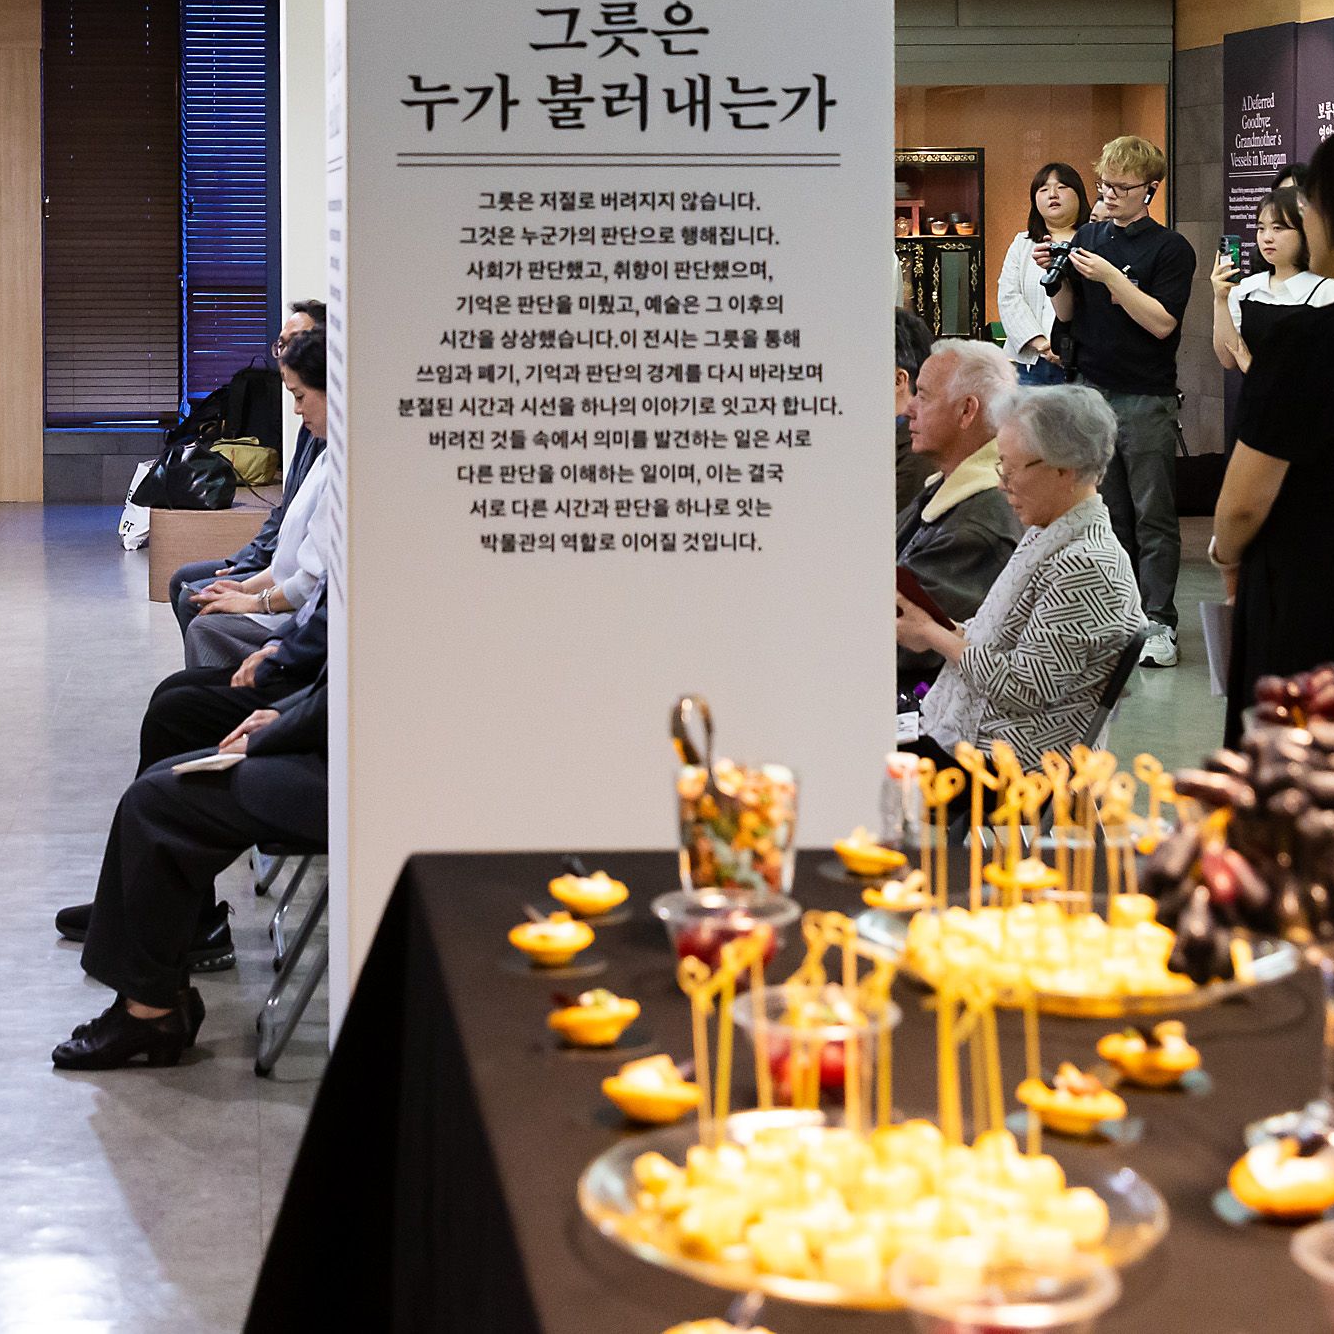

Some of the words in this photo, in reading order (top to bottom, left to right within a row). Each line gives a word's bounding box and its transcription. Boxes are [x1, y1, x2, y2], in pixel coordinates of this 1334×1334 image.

[529, 0, 710, 59] 그릇은
[400, 72, 520, 132] 누가
[1241, 96, 1247, 112] A
[1247, 92, 1275, 111] Deferred
[1230, 152, 1252, 168] Vessels
[1252, 151, 1259, 167] in
[1259, 150, 1287, 170] Yeongam
[479, 191, 535, 212] 그릇은
[540, 191, 595, 212] 저절로
[601, 191, 675, 212] 버려지지
[681, 191, 760, 212] 않습니다.
[460, 225, 515, 246] 그것은
[521, 225, 595, 246] 누군가의
[601, 225, 675, 246] 판단으로
[681, 225, 779, 246] 행해집니다.
[467, 260, 523, 281] 사회가
[528, 260, 608, 283] 판단했고,
[614, 260, 668, 281] 취향이
[674, 260, 773, 283] 판단했으며,
[456, 294, 511, 315] 기억은
[517, 294, 573, 315] 판단을
[579, 294, 639, 317] 미뤘고,
[644, 294, 700, 315] 예술은
[705, 294, 723, 315] 그
[728, 294, 783, 315] 이후의
[439, 329, 495, 350] 시간을
[500, 329, 637, 350] 상상했습니다.이
[643, 329, 698, 350] 전시는
[704, 329, 759, 350] 그릇을
[764, 329, 800, 350] 통해
[417, 363, 473, 384] 쓰임과
[478, 363, 520, 386] 폐기,
[525, 363, 581, 384] 기억과
[586, 363, 641, 384] 판단의
[647, 363, 702, 384] 경계를
[708, 363, 743, 384] 다시
[749, 363, 823, 384] 바라보며
[398, 395, 453, 416] 분절된
[459, 395, 514, 416] 시간과
[521, 395, 576, 416] 시선을
[581, 395, 636, 416] 하나의
[642, 395, 716, 416] 이야기로
[721, 395, 777, 416] 잇고자
[782, 395, 843, 416] 합니다.
[429, 429, 484, 450] 버려진
[491, 429, 527, 450] 것들
[532, 429, 587, 450] 속에서
[593, 429, 648, 450] 의미를
[654, 429, 728, 450] 발견하는
[734, 429, 770, 450] 일은
[775, 429, 812, 450] 서로
[457, 463, 494, 484] 다른
[499, 463, 555, 484] 판단을
[560, 463, 634, 484] 이해하는
[640, 463, 701, 485] 일이며,
[706, 463, 742, 484] 이는
[748, 463, 784, 484] 결국
[469, 498, 506, 519] 서로
[512, 498, 548, 519] 다른
[554, 498, 609, 519] 시간과
[614, 498, 670, 519] 판단을
[675, 498, 731, 519] 하나로
[736, 498, 772, 519] 잇는
[481, 532, 555, 553] 박물관의
[560, 532, 616, 553] 역할로
[622, 532, 676, 553] 이어질
[683, 532, 762, 553] 것입니다.
